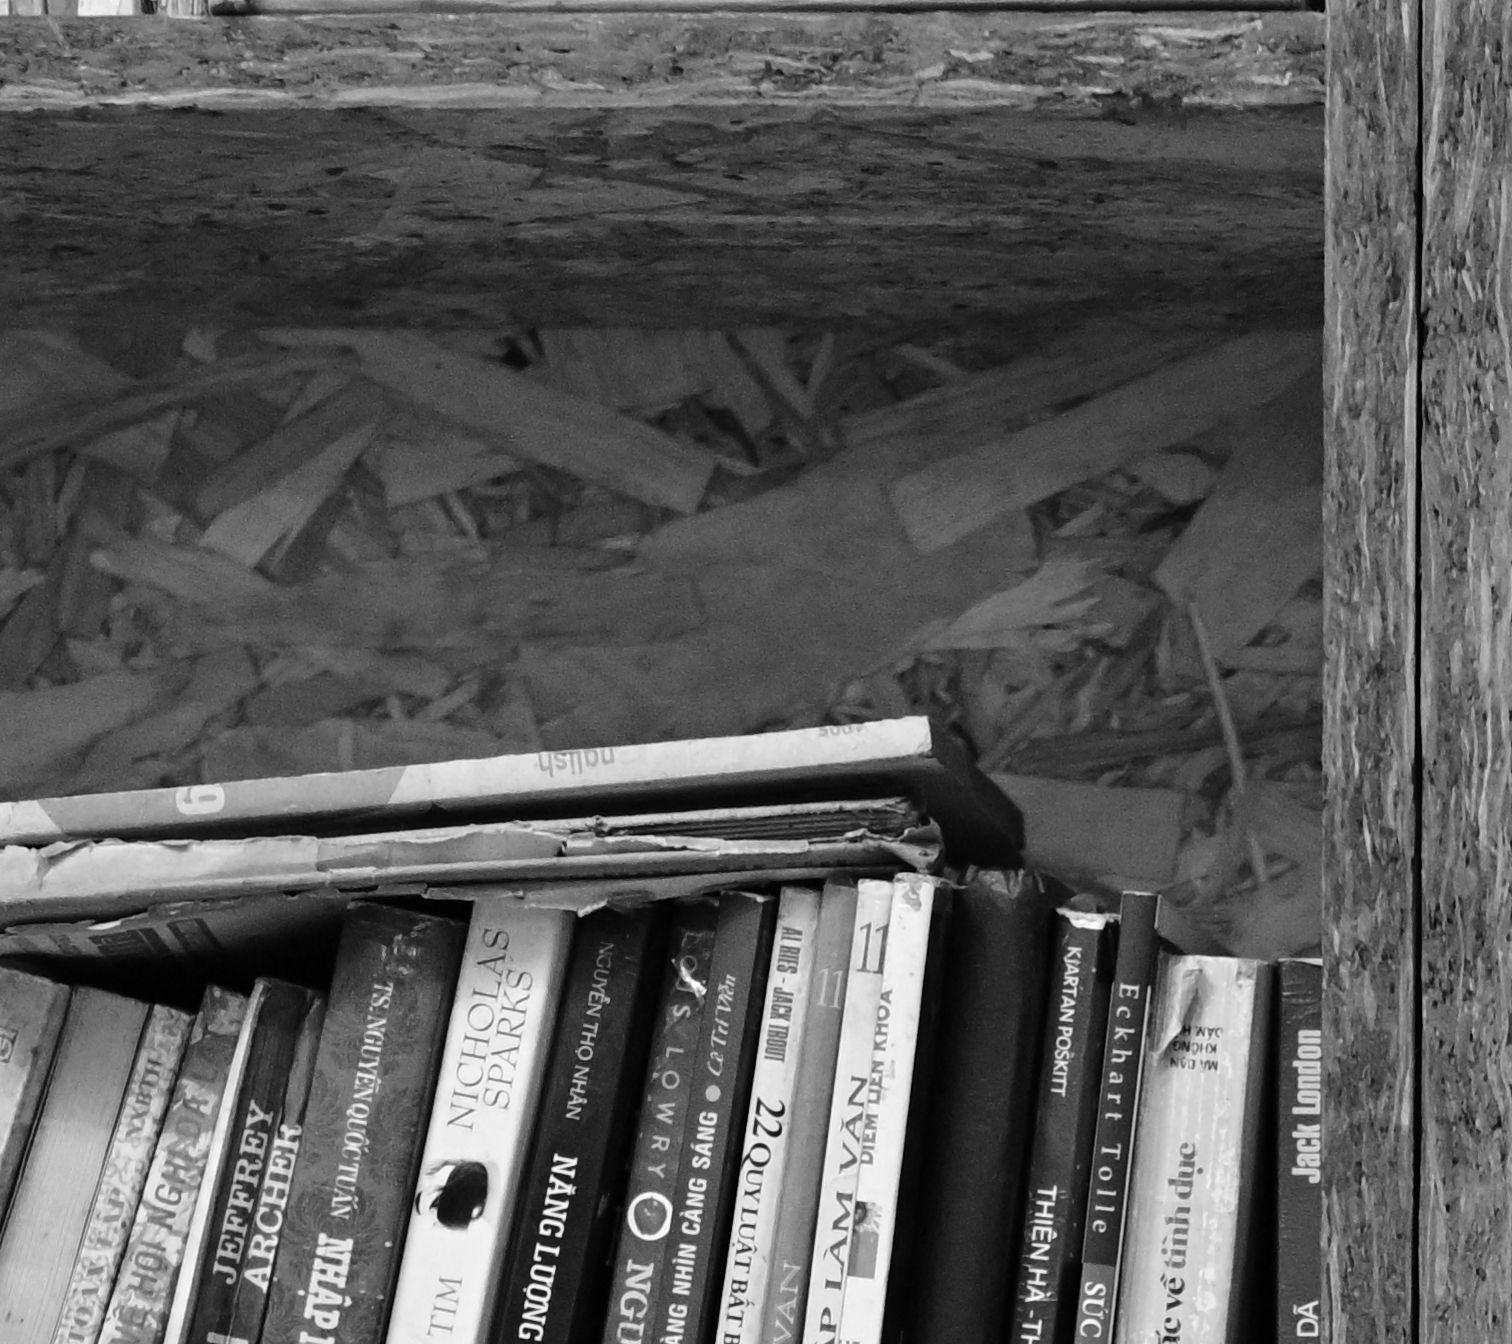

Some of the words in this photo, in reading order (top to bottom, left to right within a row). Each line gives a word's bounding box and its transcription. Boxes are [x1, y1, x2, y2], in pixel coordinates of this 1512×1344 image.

[447, 922, 512, 1129] NICHOLAS
[483, 964, 537, 1110] SPARKS
[1292, 1030, 1322, 1115] London
[690, 1111, 718, 1169] SÁNG
[1292, 1124, 1321, 1184] Jack
[679, 1178, 707, 1235] CÀNG
[297, 1233, 354, 1329] NHẬP
[672, 1243, 697, 1295] NHÌN
[1293, 1300, 1319, 1337] DÃ
